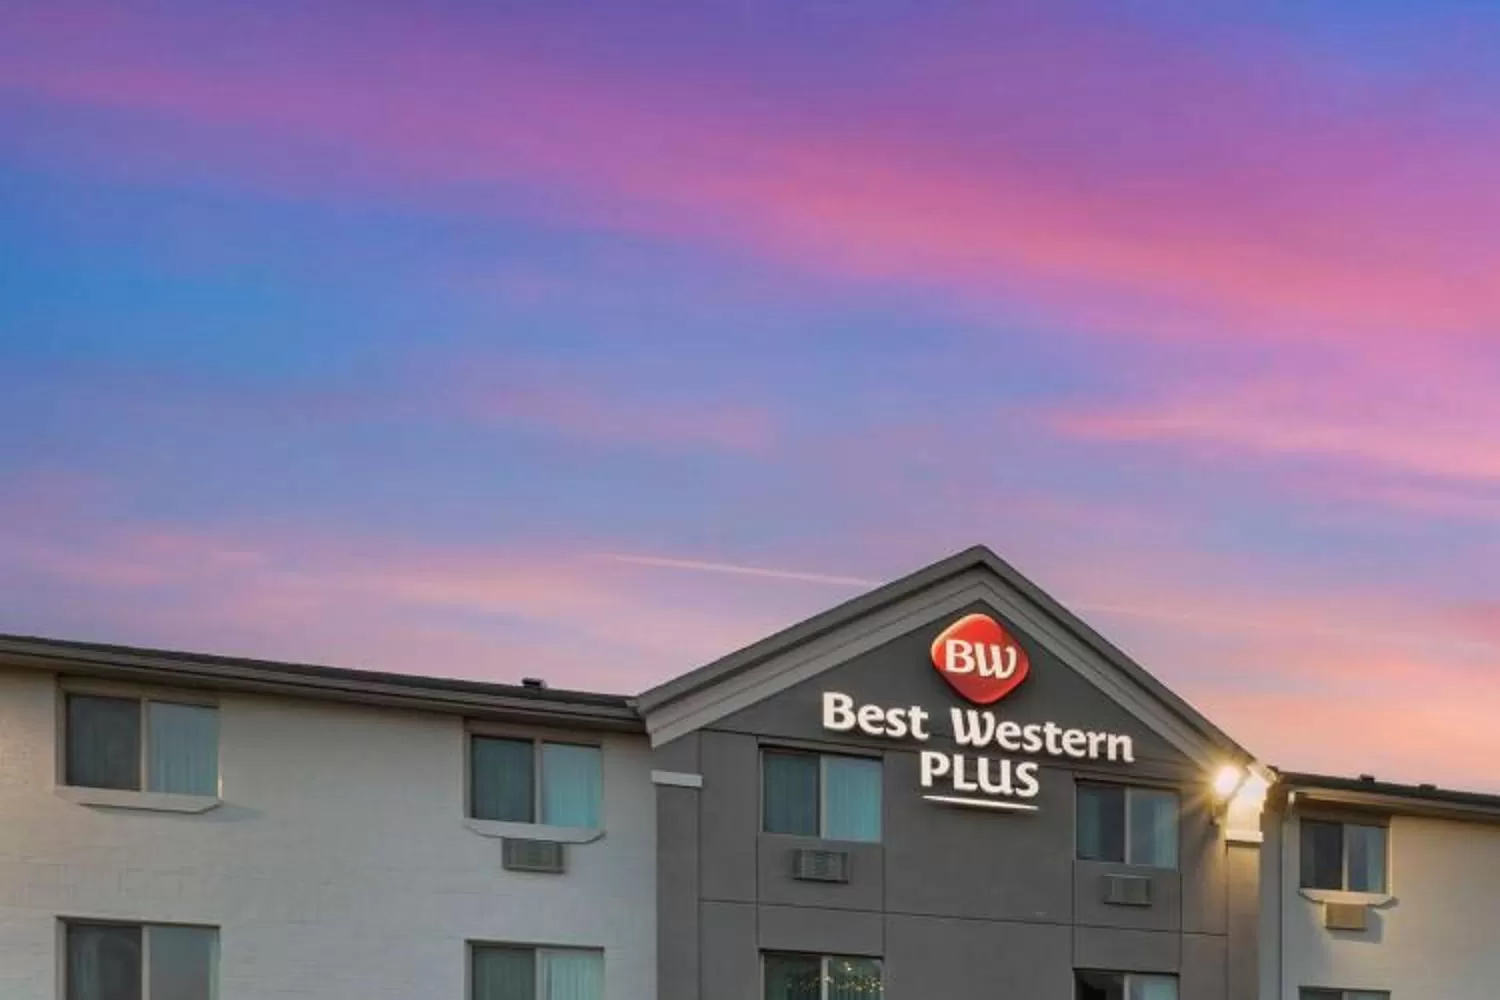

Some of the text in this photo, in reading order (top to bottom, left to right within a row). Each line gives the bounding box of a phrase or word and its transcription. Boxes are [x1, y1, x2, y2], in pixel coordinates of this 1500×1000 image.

[945, 640, 1017, 679] BW
[822, 692, 1135, 763] Best Western
[920, 751, 1040, 797] PLUS
